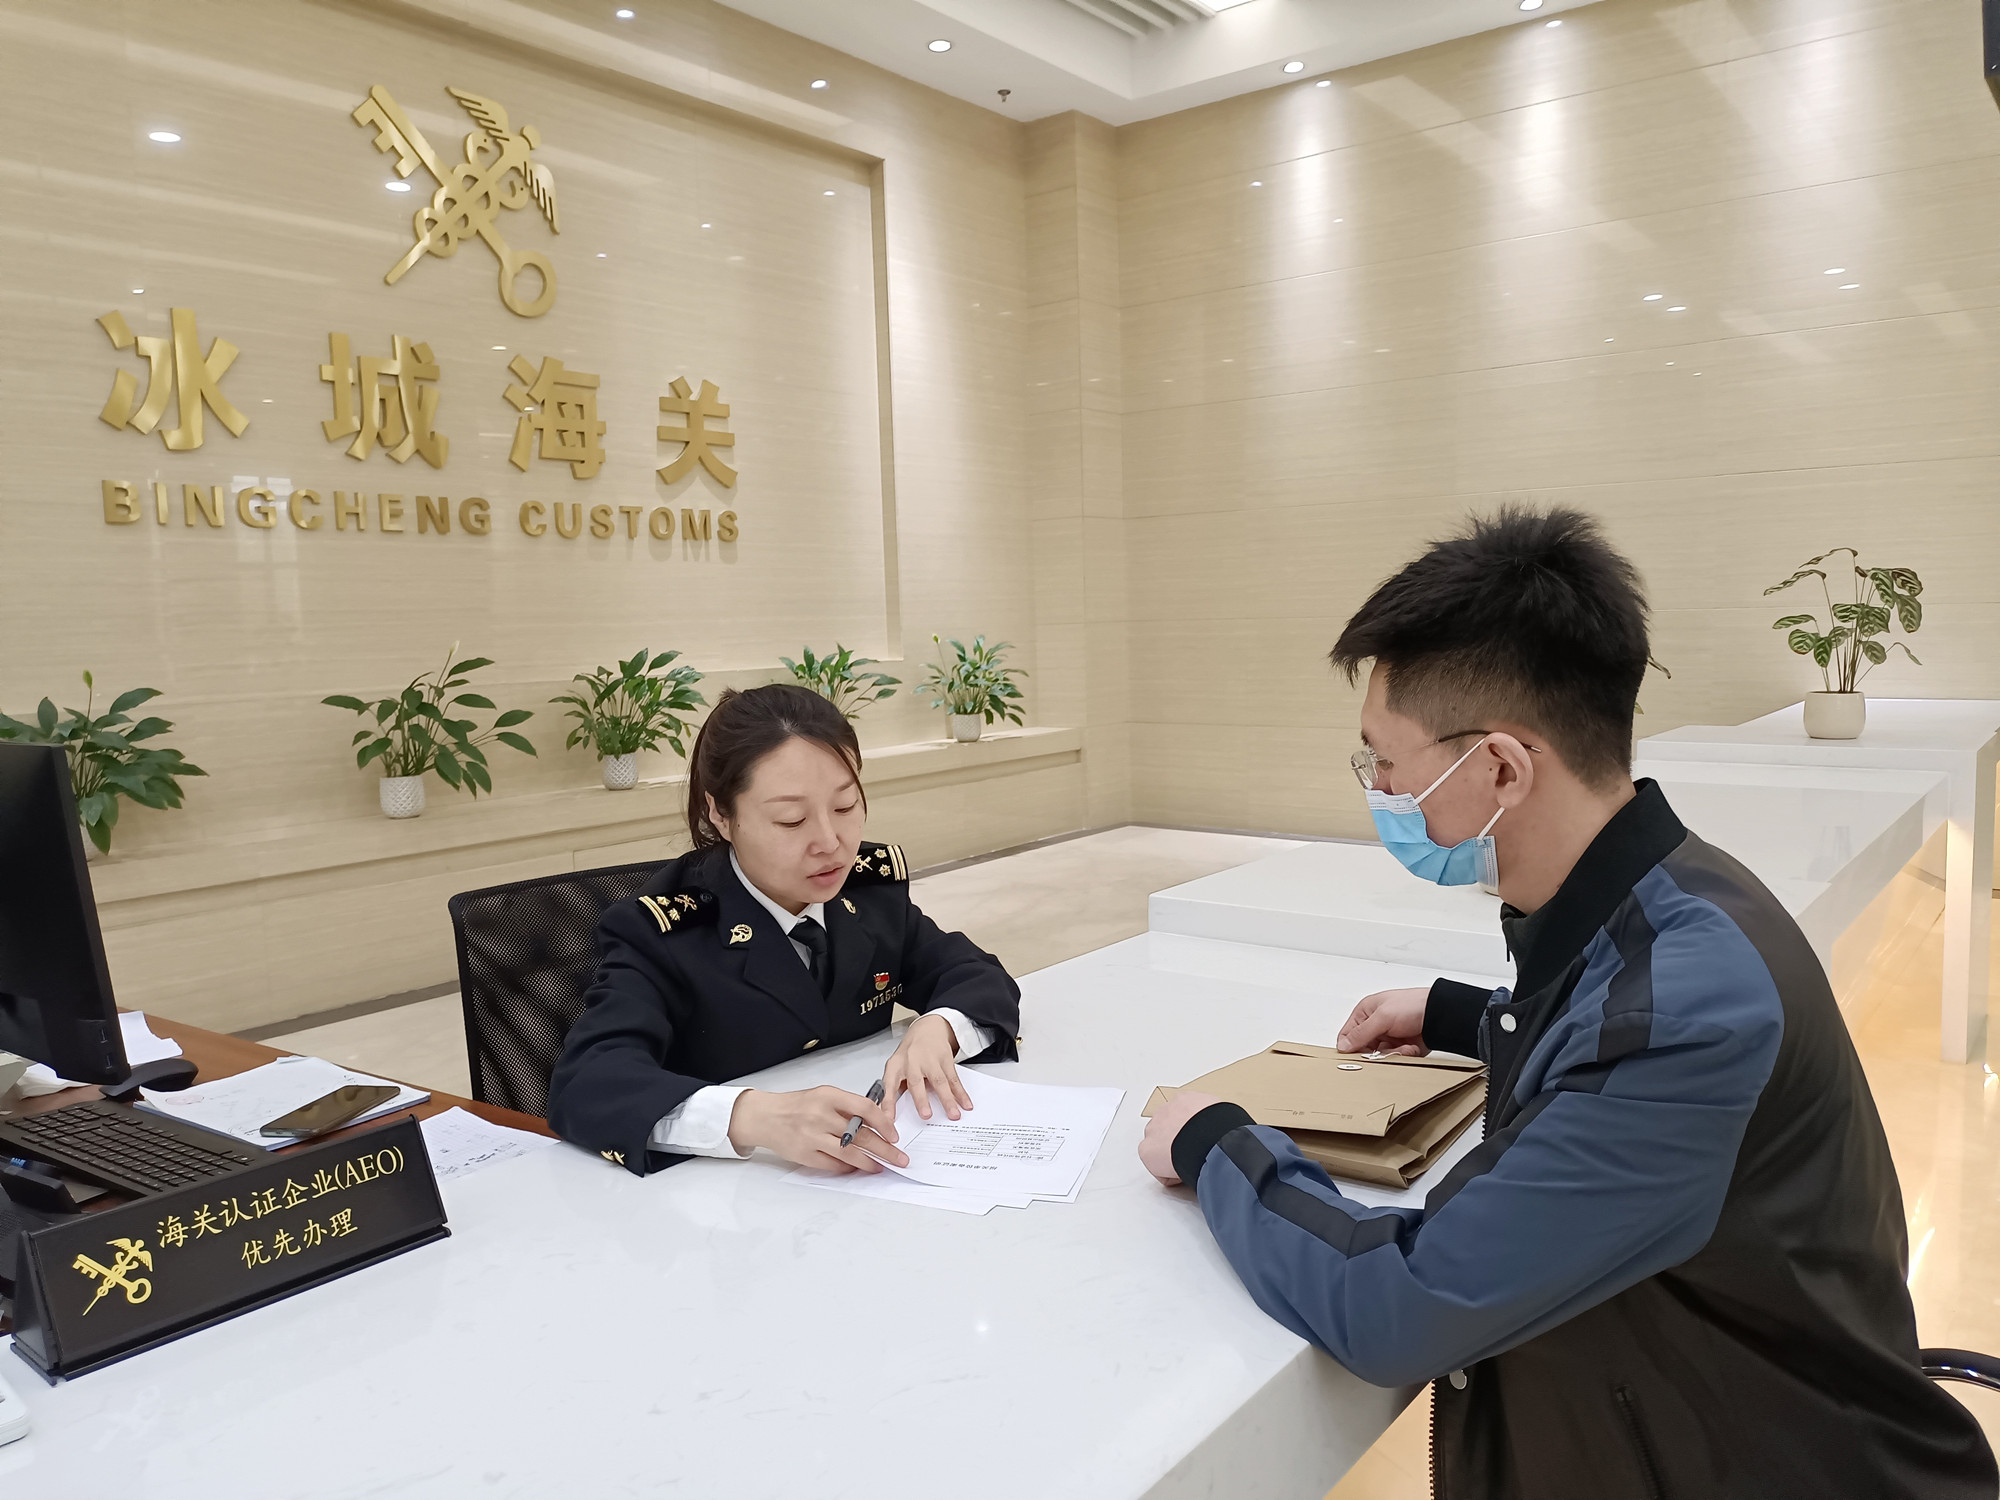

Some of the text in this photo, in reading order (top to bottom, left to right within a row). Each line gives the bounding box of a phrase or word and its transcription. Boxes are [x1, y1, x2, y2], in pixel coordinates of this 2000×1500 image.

[97, 307, 739, 487] 冰城海关
[101, 479, 740, 542] BINGCHENG CUSTOMS
[156, 1146, 405, 1249] 海关认证企业(AEO)
[241, 1207, 358, 1269] 优先办理
